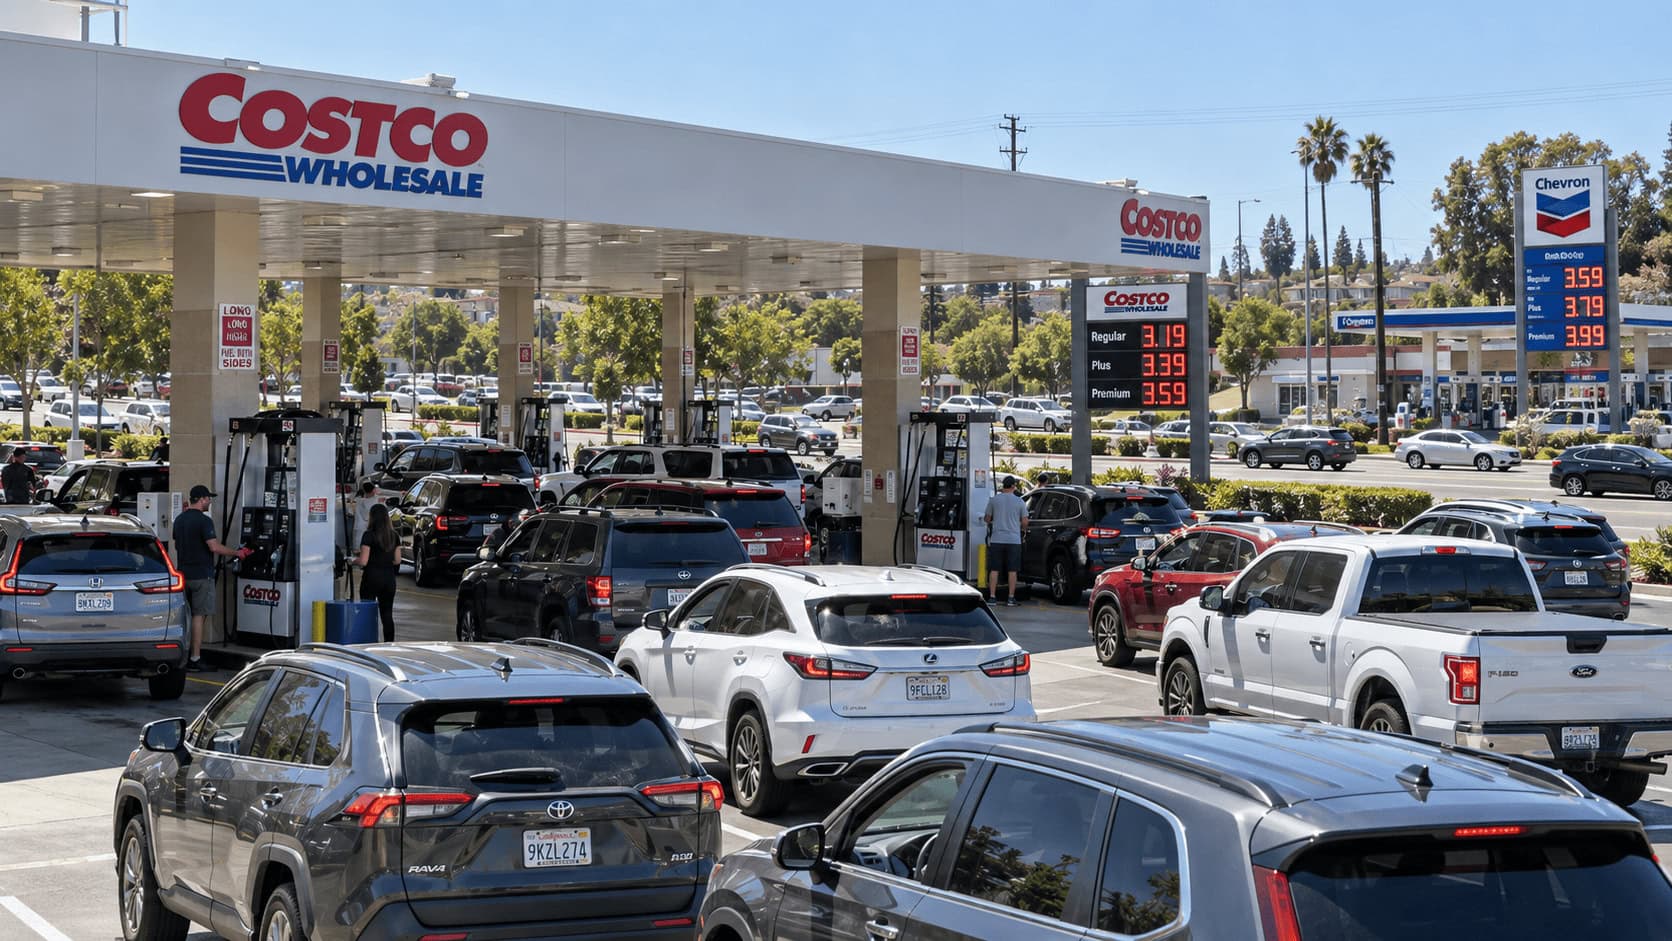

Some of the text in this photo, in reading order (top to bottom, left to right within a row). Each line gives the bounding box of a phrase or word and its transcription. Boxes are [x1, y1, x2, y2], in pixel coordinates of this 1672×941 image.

[179, 72, 489, 167] COSTCO
[284, 156, 484, 199] WHOLESALE
[1535, 177, 1590, 190] Chevron
[1120, 198, 1202, 242] COSTCO
[1147, 240, 1201, 260] WHOLESALE
[1564, 266, 1603, 288] 3.59
[1103, 290, 1170, 306] COSTCO
[1564, 295, 1604, 317] 3.79
[1091, 324, 1185, 348] Regular 3.19
[1565, 324, 1605, 347] 3.99
[1091, 353, 1185, 377] Plus 3.39
[1091, 382, 1186, 405] Premium 3.59
[528, 841, 587, 861] 9KZL274
